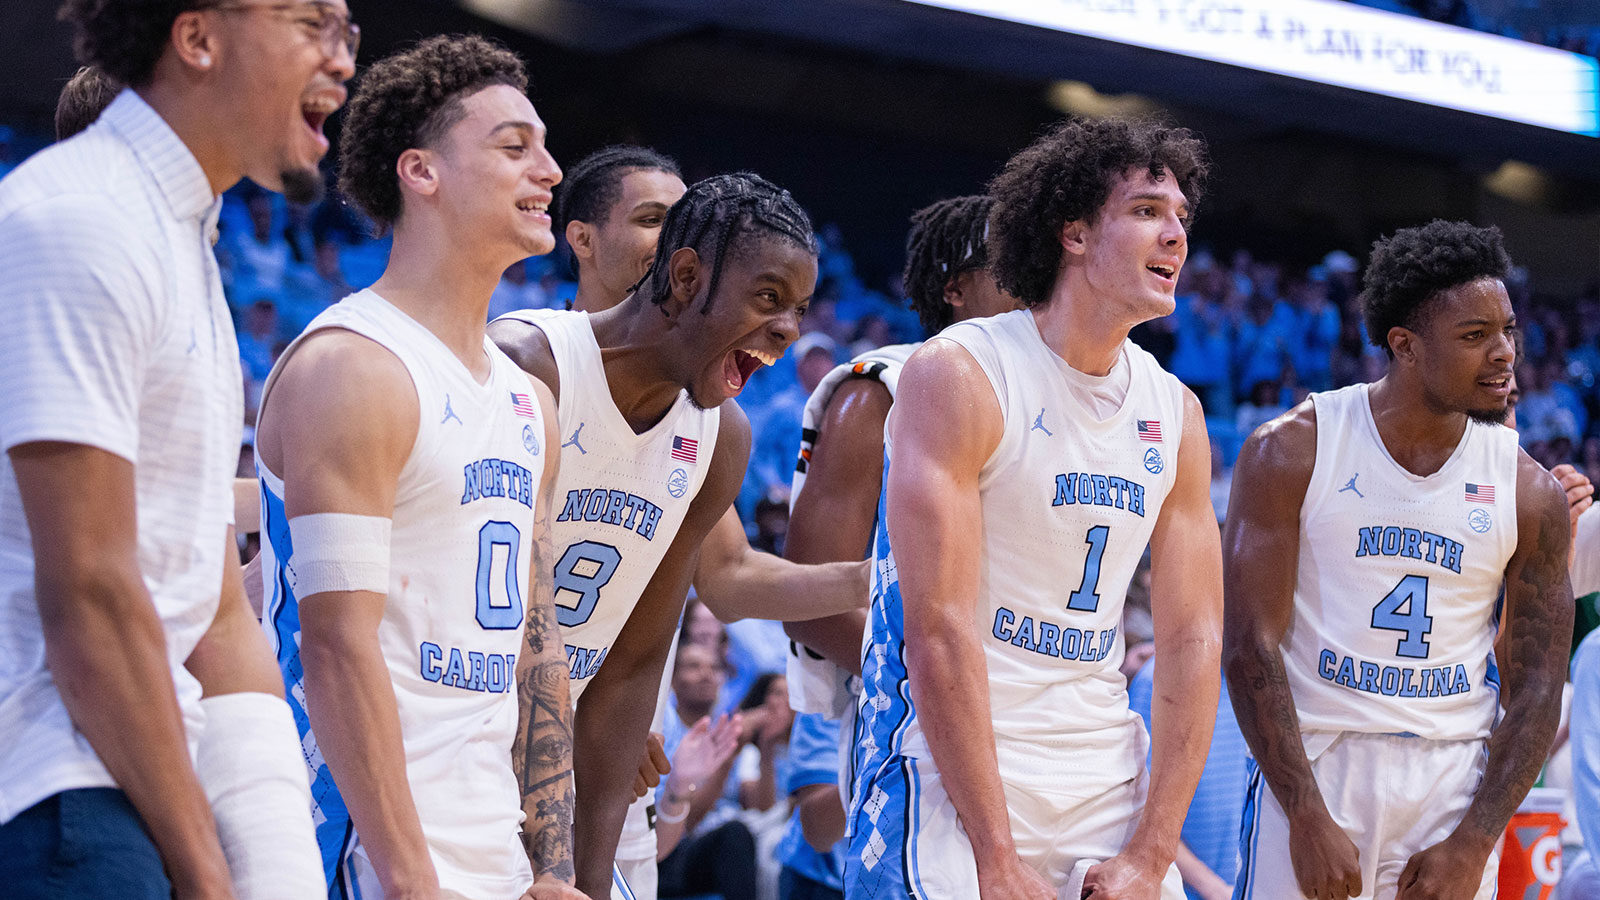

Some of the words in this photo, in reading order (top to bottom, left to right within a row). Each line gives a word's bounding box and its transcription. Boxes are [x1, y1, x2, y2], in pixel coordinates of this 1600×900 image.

[461, 458, 533, 509] NORTH
[1052, 472, 1145, 517] NORTH
[556, 488, 664, 541] NORTH
[475, 519, 524, 630] 0
[1066, 524, 1110, 613] 1
[1355, 526, 1464, 574] NORTH
[554, 540, 622, 627] 8
[1370, 573, 1433, 659] 4
[1318, 648, 1471, 697] CAROLINA
[1531, 836, 1562, 886] G
